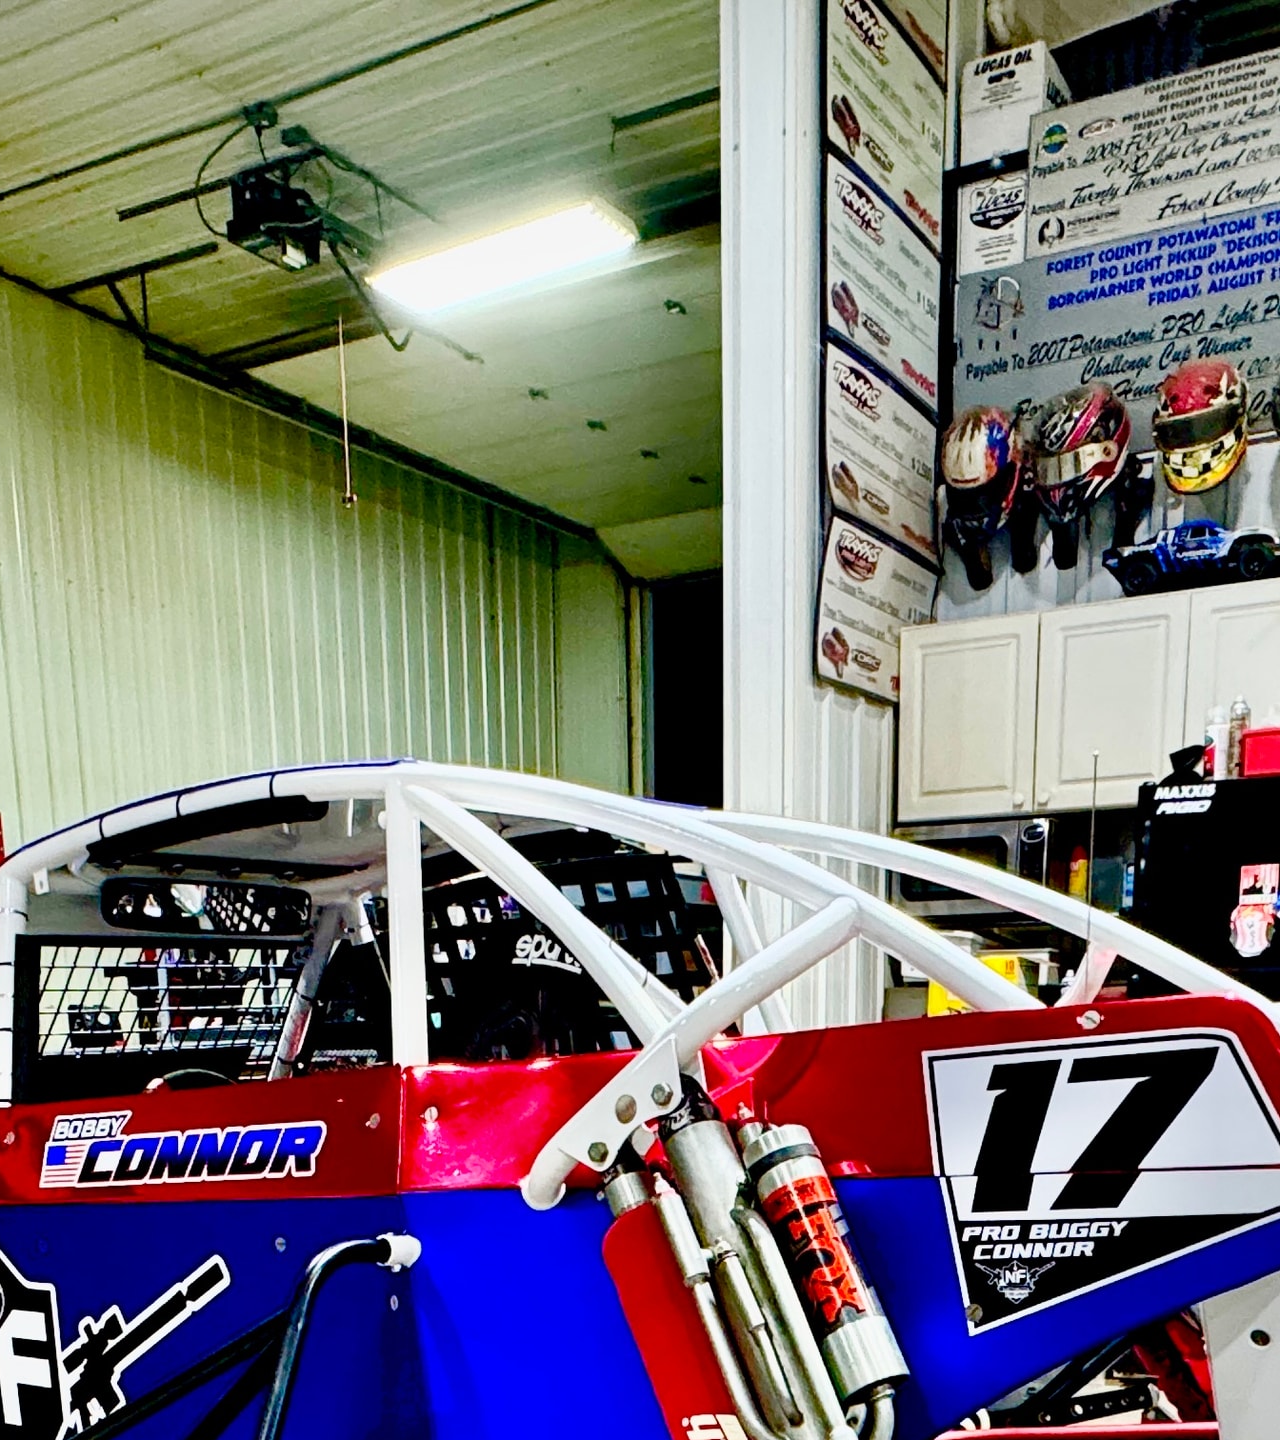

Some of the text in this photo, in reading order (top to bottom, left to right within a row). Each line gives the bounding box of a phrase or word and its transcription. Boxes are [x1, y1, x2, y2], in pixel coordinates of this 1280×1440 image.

[974, 49, 1033, 76] LUCAS OIL
[1144, 80, 1175, 95] FOREST
[1178, 69, 1215, 86] COUNTY
[1159, 68, 1266, 102] DECISION AT SUNDOWN
[1122, 112, 1140, 123] PRO
[1142, 104, 1168, 120] LIGHT
[1170, 95, 1203, 112] PICKUP
[1205, 81, 1258, 102] CHALLENGE
[1260, 76, 1278, 89] CUP
[1170, 107, 1206, 122] AUGUST
[1046, 252, 1095, 276] FOREST
[1098, 239, 1153, 262] COUNTY
[1158, 217, 1256, 250] POTAWATOMI
[1090, 266, 1118, 284] PRO
[1123, 254, 1163, 277] LIGHT
[1168, 242, 1217, 267] PICKUP
[1048, 276, 1146, 311] BORGWARNER
[1150, 264, 1203, 288] WORLD
[1208, 269, 1265, 294] AUGUST
[966, 357, 1009, 382] Payable
[1012, 353, 1024, 370] To
[1027, 337, 1069, 366] 2007
[1069, 323, 1156, 358] Potawatomi
[1161, 310, 1205, 340] PRO
[1080, 335, 1253, 385] Challenge Cup Winner
[1154, 783, 1216, 800] MAXXIS
[54, 1116, 125, 1140] BOBBY
[971, 1046, 1220, 1213] 17
[76, 1125, 324, 1185] CONNOR
[962, 1220, 1130, 1242] PRO BUGGY
[973, 1240, 1094, 1261] CONNOR
[1005, 1268, 1027, 1282] NF
